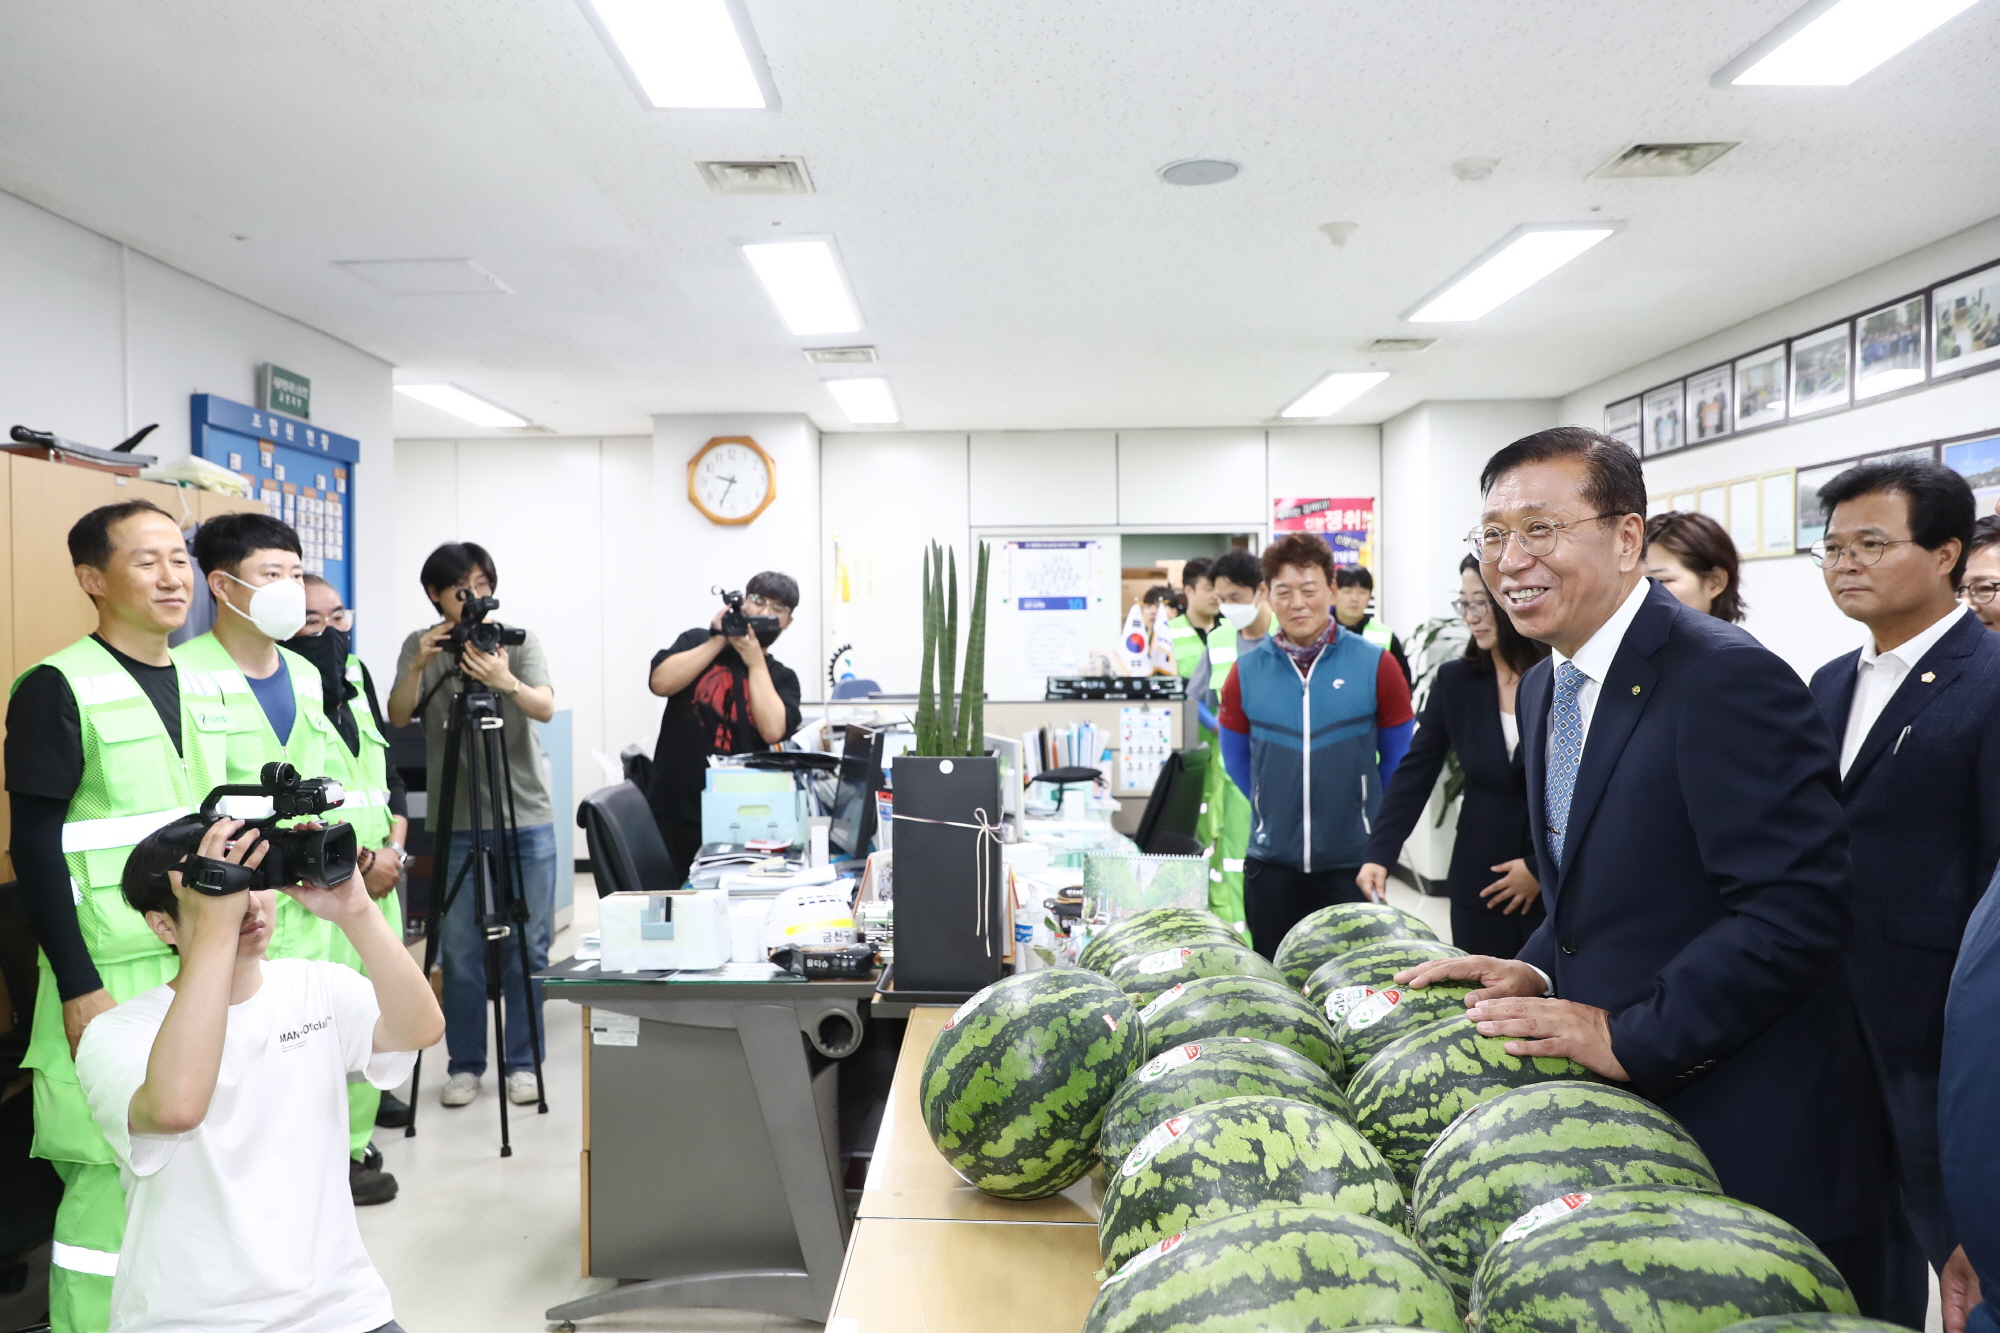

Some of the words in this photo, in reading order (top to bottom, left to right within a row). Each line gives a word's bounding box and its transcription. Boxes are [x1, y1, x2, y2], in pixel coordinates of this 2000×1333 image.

[196, 881, 223, 891] Panasonic
[822, 931, 852, 943] 금천구
[806, 958, 830, 969] 물티슈
